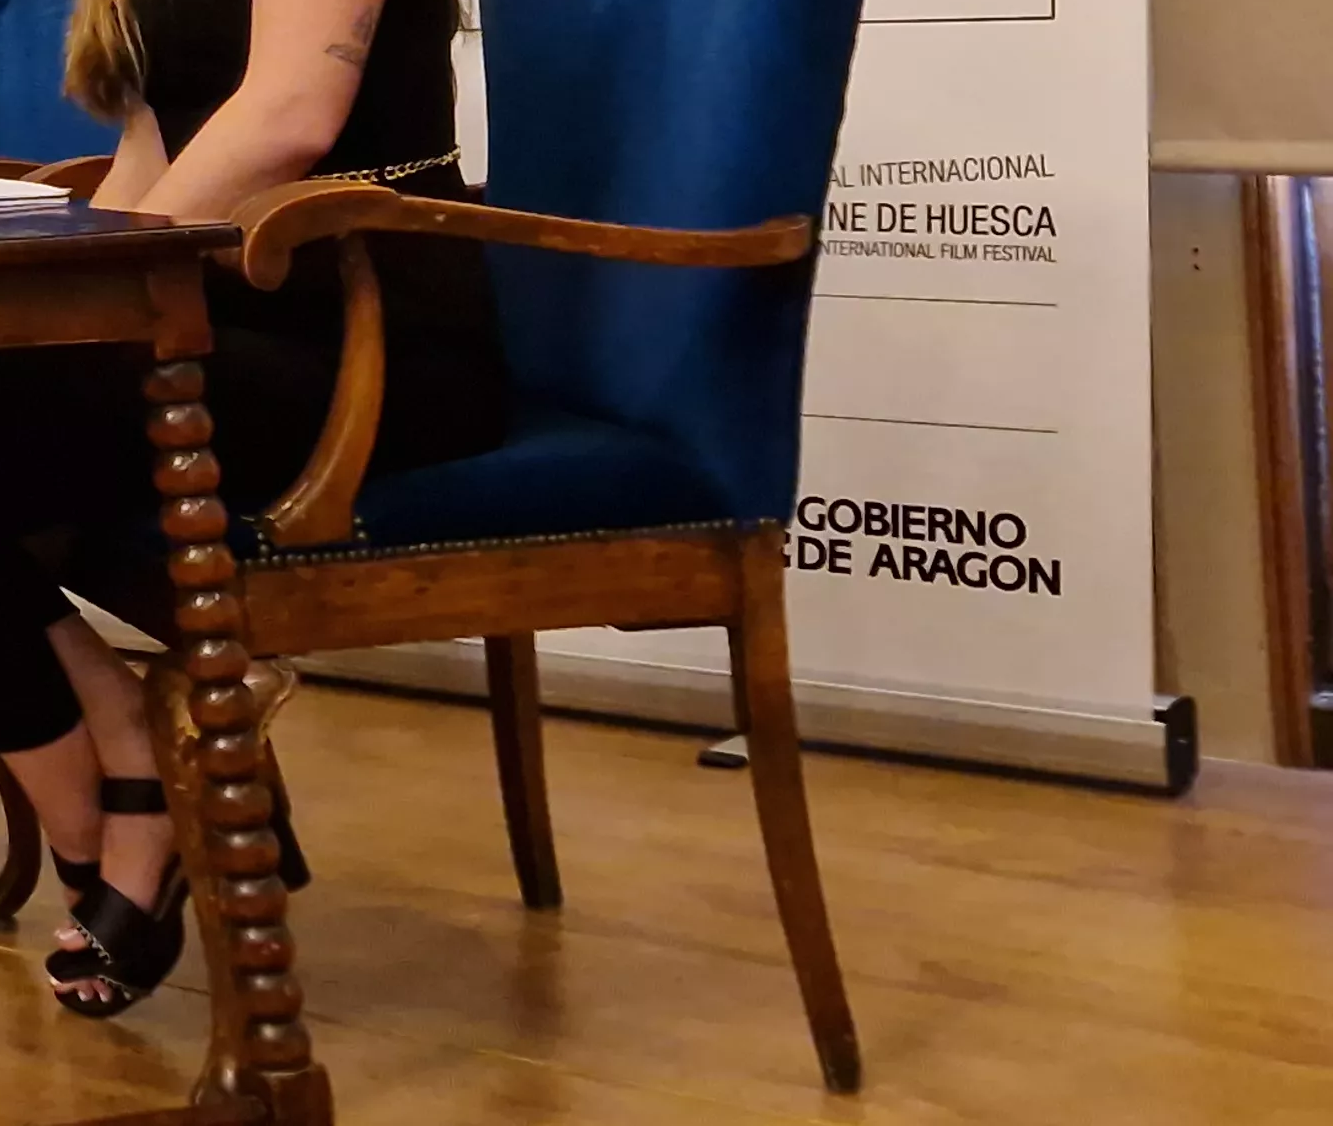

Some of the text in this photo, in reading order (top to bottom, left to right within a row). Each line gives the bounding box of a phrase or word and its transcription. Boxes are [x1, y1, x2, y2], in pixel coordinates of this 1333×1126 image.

[860, 153, 1055, 187] INTERNACIONAL
[876, 202, 918, 234] DE
[926, 204, 1057, 237] HUESCA
[819, 240, 1058, 264] NTERNATIONAL FILM FESTIVAL
[796, 495, 1027, 550] GOBIERNO
[796, 536, 1062, 596] DE ARAGON
